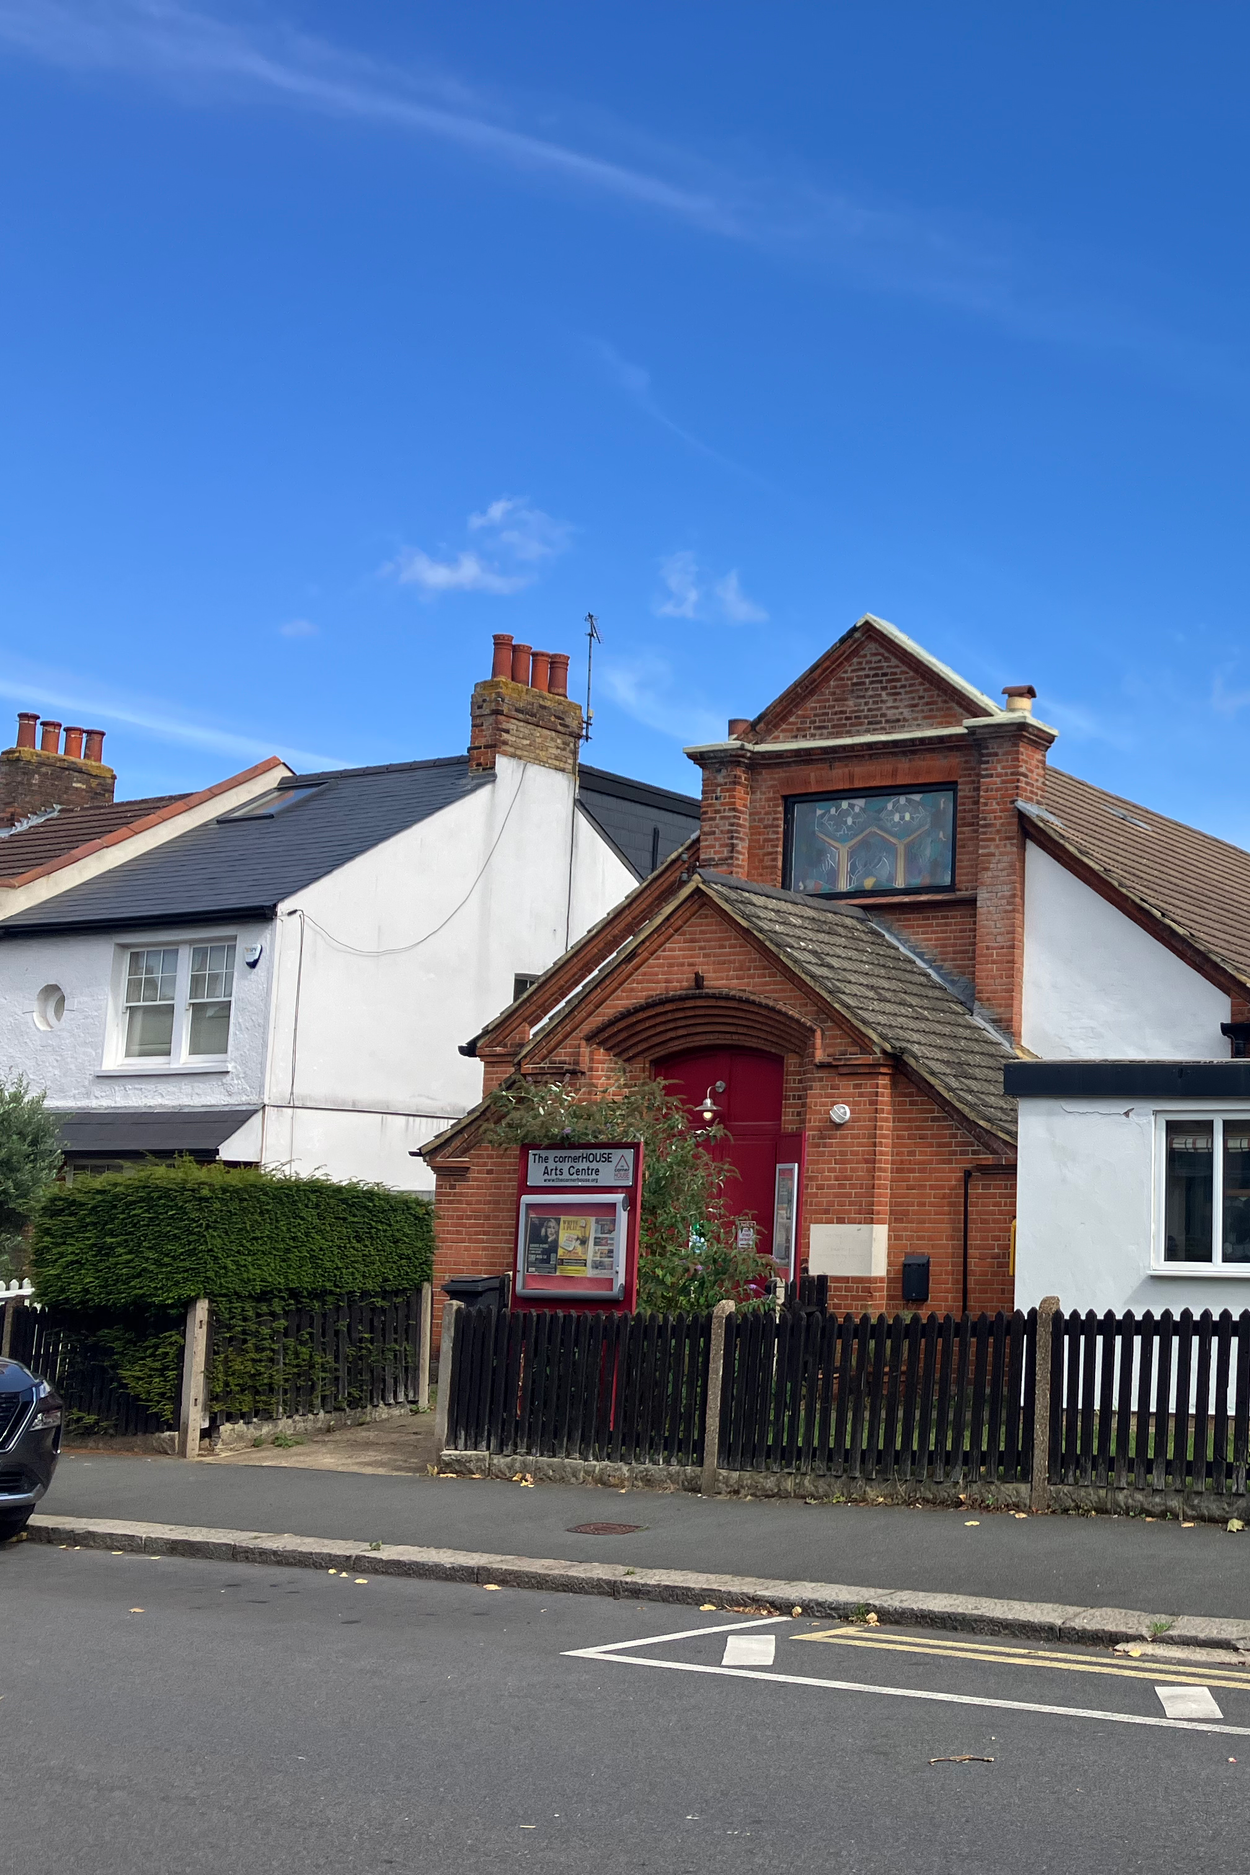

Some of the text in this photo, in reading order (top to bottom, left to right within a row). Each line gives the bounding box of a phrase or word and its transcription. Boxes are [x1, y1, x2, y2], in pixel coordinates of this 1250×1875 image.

[532, 1152, 613, 1163] The cornerHOUSE
[542, 1165, 600, 1176] Arts Centre
